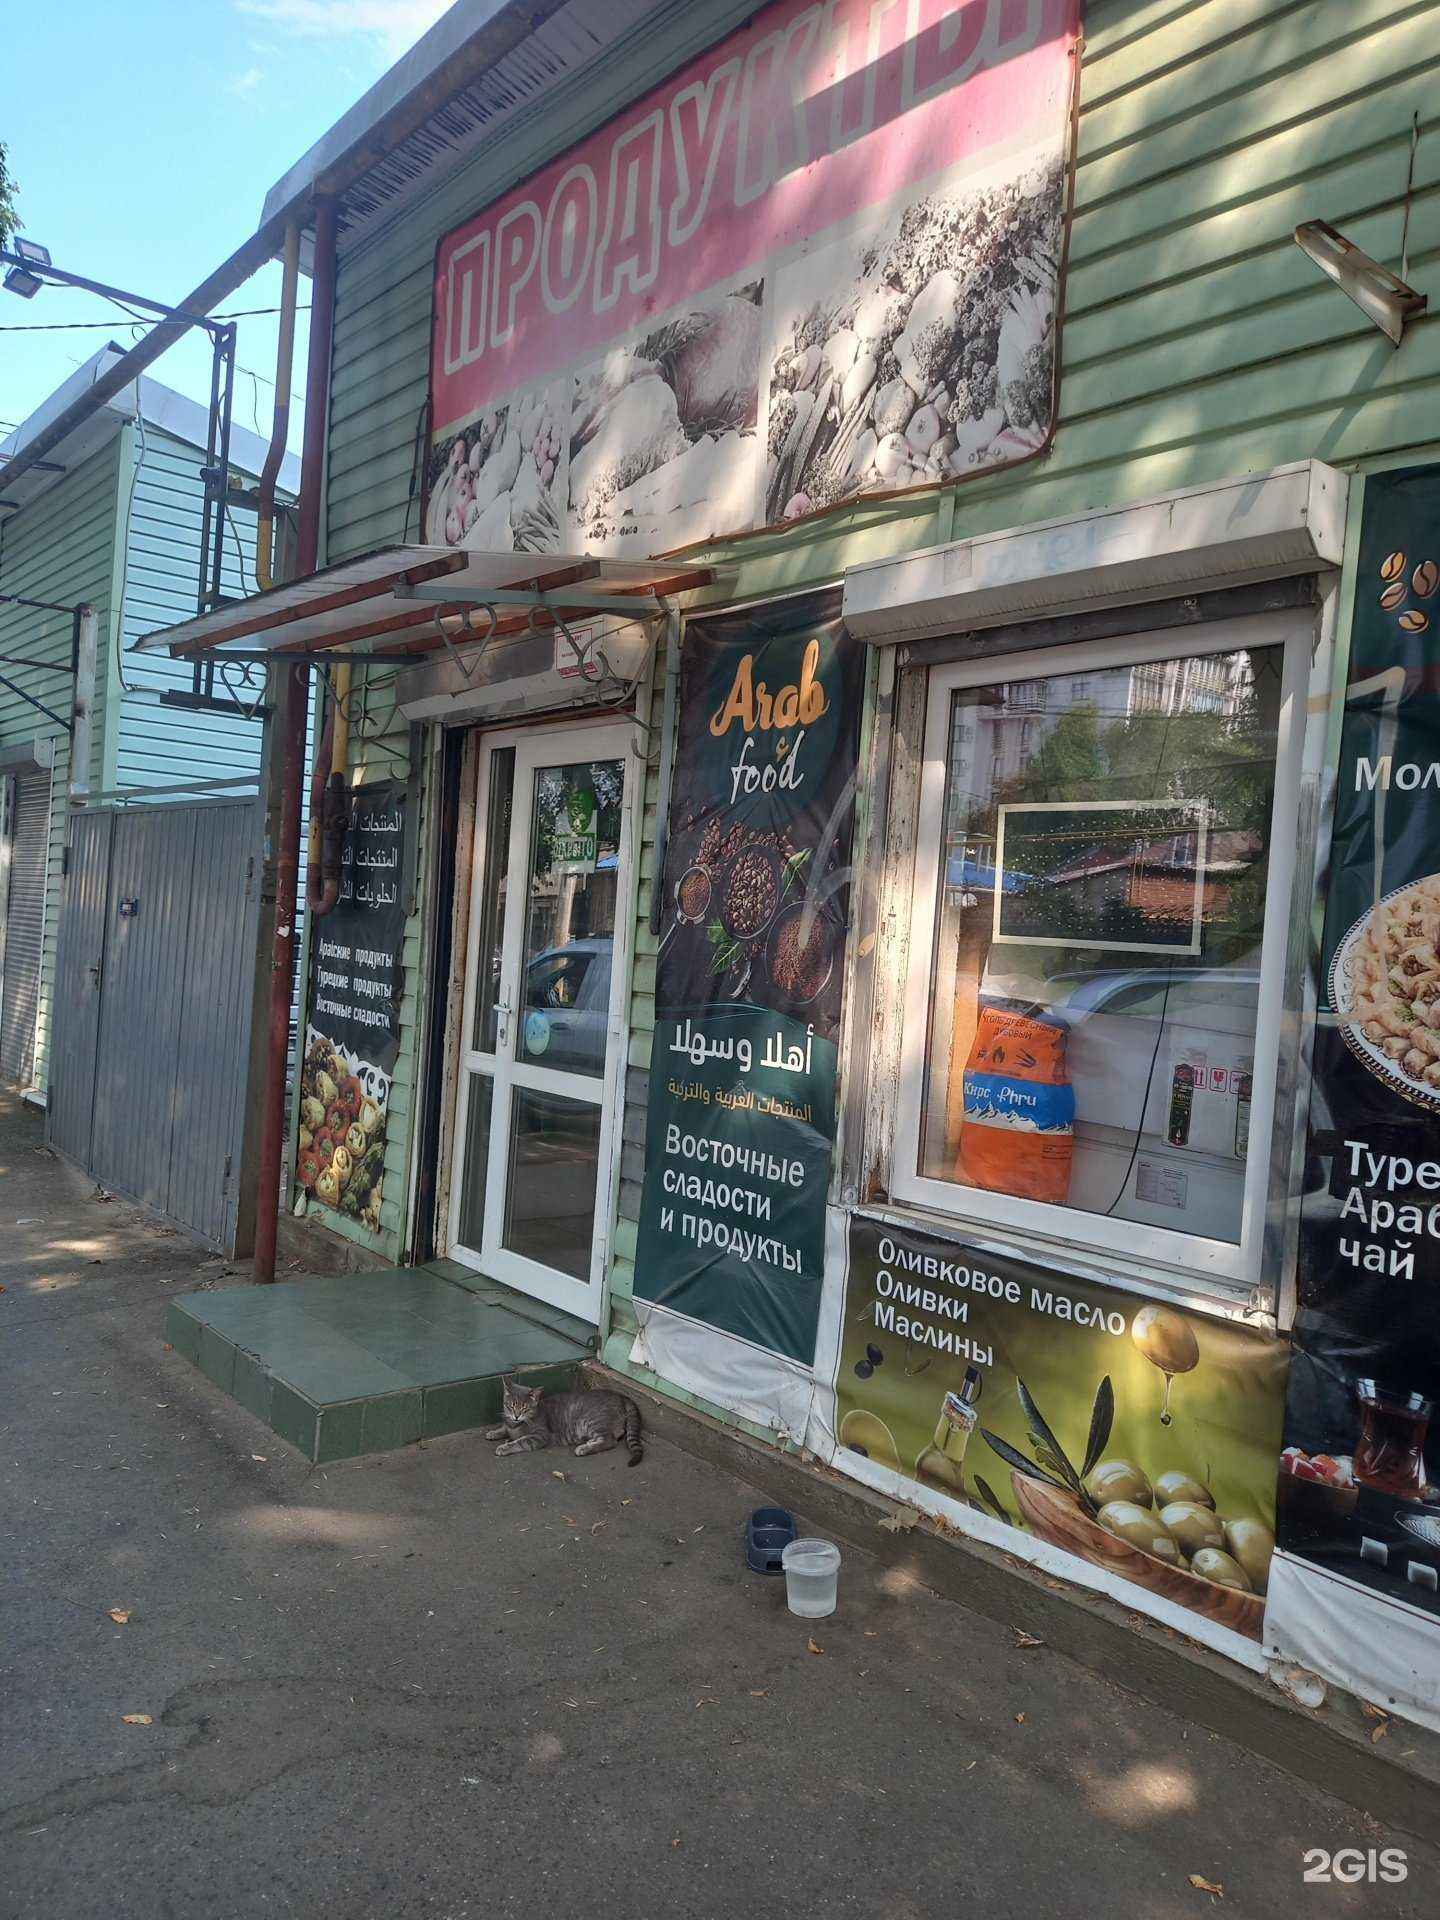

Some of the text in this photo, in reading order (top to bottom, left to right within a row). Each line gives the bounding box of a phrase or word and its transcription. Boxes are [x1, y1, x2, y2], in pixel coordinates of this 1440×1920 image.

[709, 638, 831, 737] Arab
[730, 729, 806, 805] food
[360, 811, 402, 836] المنتجات
[356, 846, 398, 872] المنتجات
[319, 938, 393, 970] Арабские продукты
[317, 965, 392, 999] Турецкие продукты
[316, 993, 391, 1029] Восточные сладости
[669, 1018, 815, 1075] أهلا وسهلا
[757, 1096, 812, 1122] المنتجات
[963, 1082, 991, 1099] Кирс
[665, 1123, 805, 1187] Восточные
[663, 1169, 771, 1221] сладости
[660, 1207, 802, 1274] и продукты
[1339, 1237, 1415, 1281] чай
[875, 1270, 969, 1323] Оливки
[878, 1237, 1126, 1336] Оливковое масло
[874, 1301, 993, 1367] Маслины
